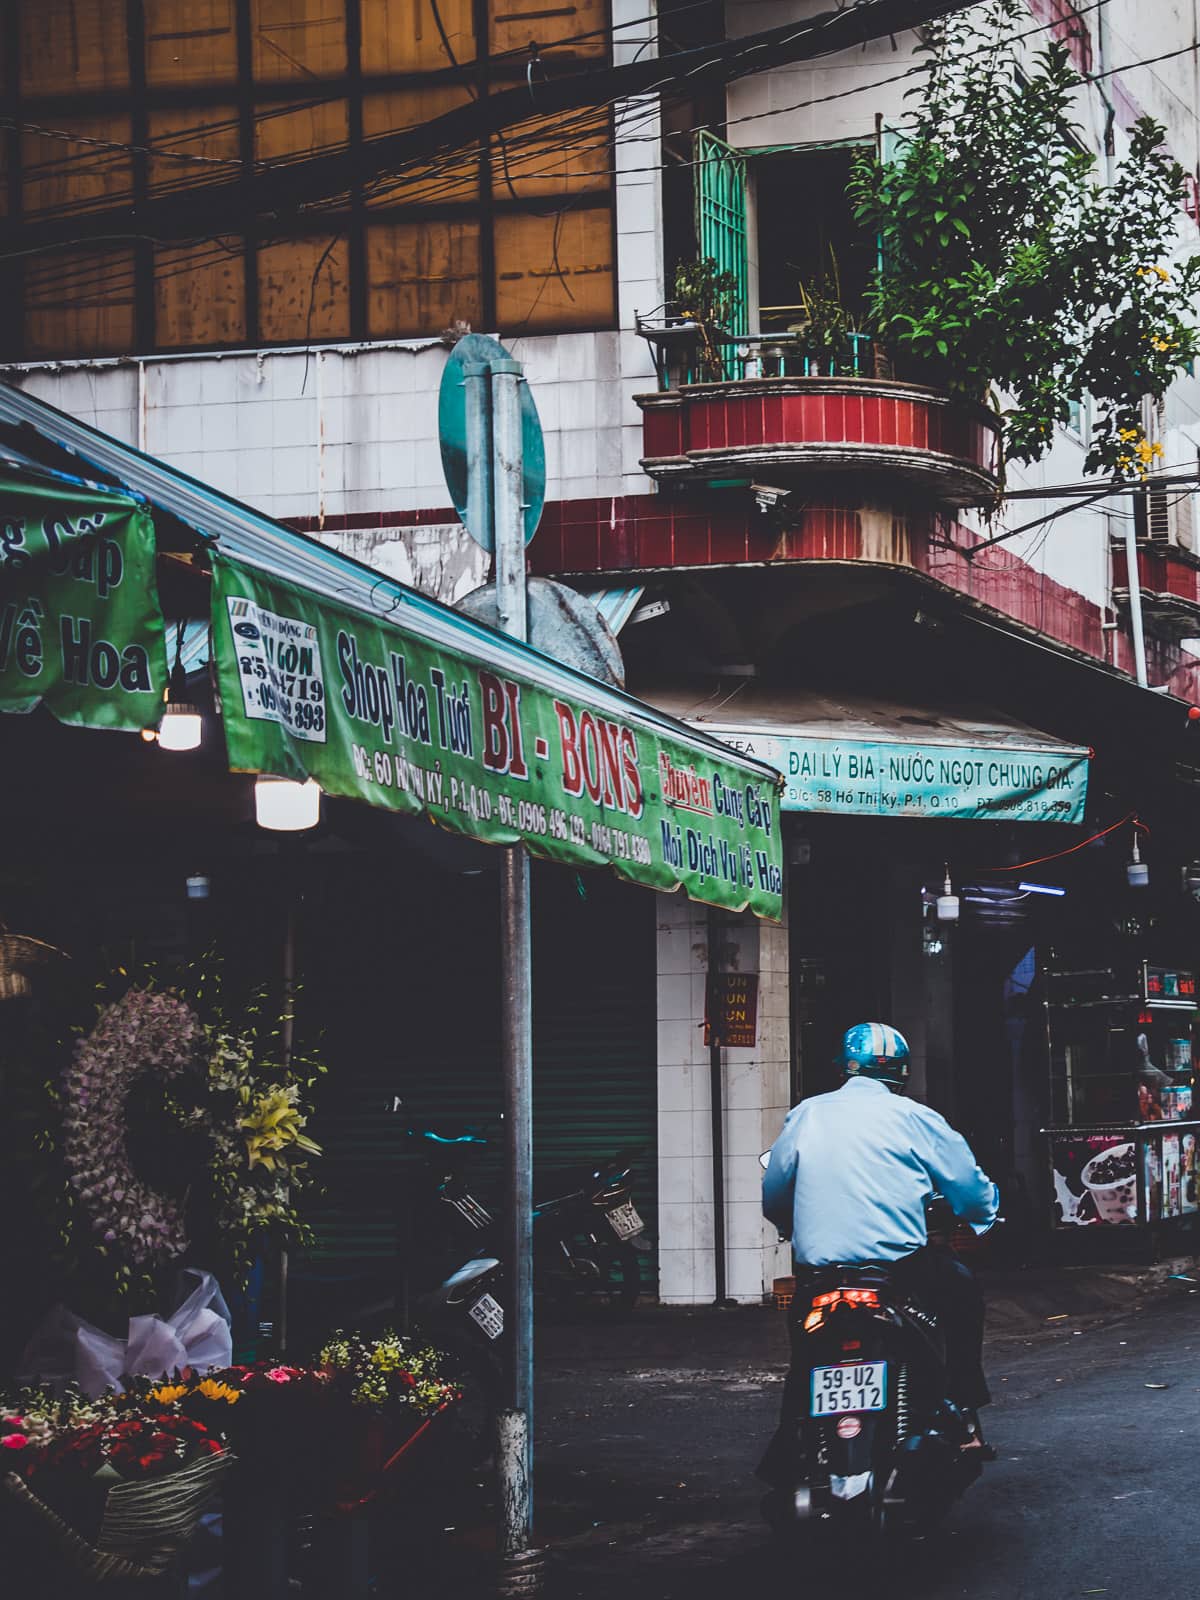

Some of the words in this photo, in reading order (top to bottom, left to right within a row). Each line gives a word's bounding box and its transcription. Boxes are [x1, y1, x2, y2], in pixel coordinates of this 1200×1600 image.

[60, 614, 155, 694] Hoa
[337, 629, 394, 744] Shop
[390, 651, 432, 746] Hoa
[430, 667, 475, 760] Tươi
[479, 670, 529, 780] BI
[553, 699, 643, 820] BONS
[374, 751, 393, 786] 60
[518, 800, 546, 835] 0906
[549, 808, 567, 840] 496
[789, 751, 816, 784] ĐẠI
[822, 747, 842, 777] LÝ
[848, 755, 875, 780] BIA
[889, 752, 935, 783] NƯỚC
[940, 760, 984, 792] NGỌT
[988, 762, 1042, 790] CHUNG
[817, 789, 832, 803] 58
[713, 773, 745, 830] Cung
[745, 784, 772, 838] Cấp
[686, 828, 719, 885] Dịch
[719, 839, 737, 893] Vụ
[755, 850, 782, 896] Hoa
[816, 1388, 881, 1412] 155.12
[823, 1367, 875, 1389] 59-U2
